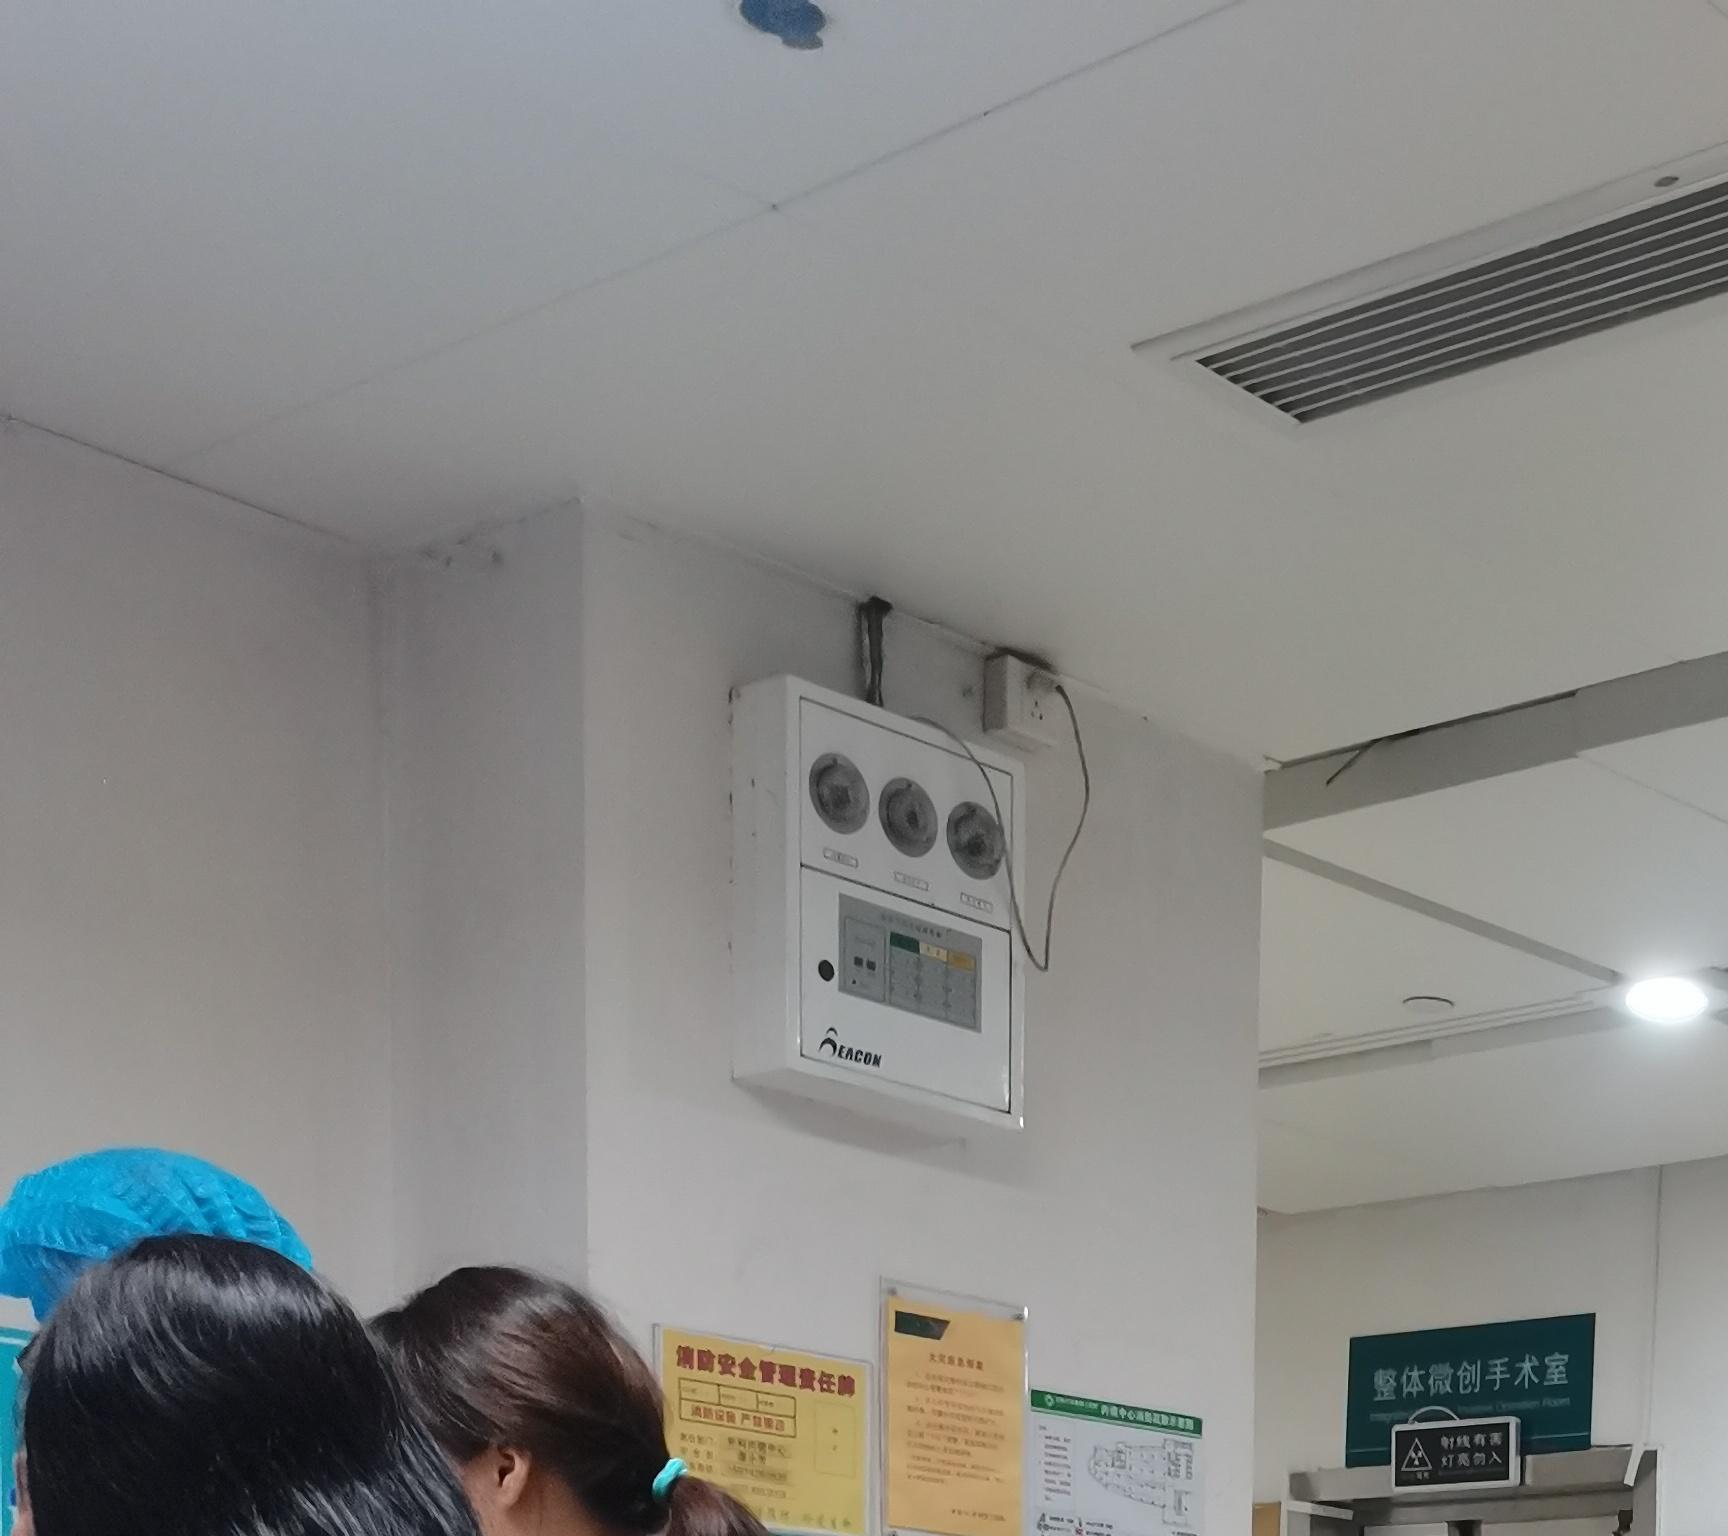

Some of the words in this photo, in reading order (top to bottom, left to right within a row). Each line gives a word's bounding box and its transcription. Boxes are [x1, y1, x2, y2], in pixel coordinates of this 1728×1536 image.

[1373, 1352, 1570, 1401] 整体微创手术室
